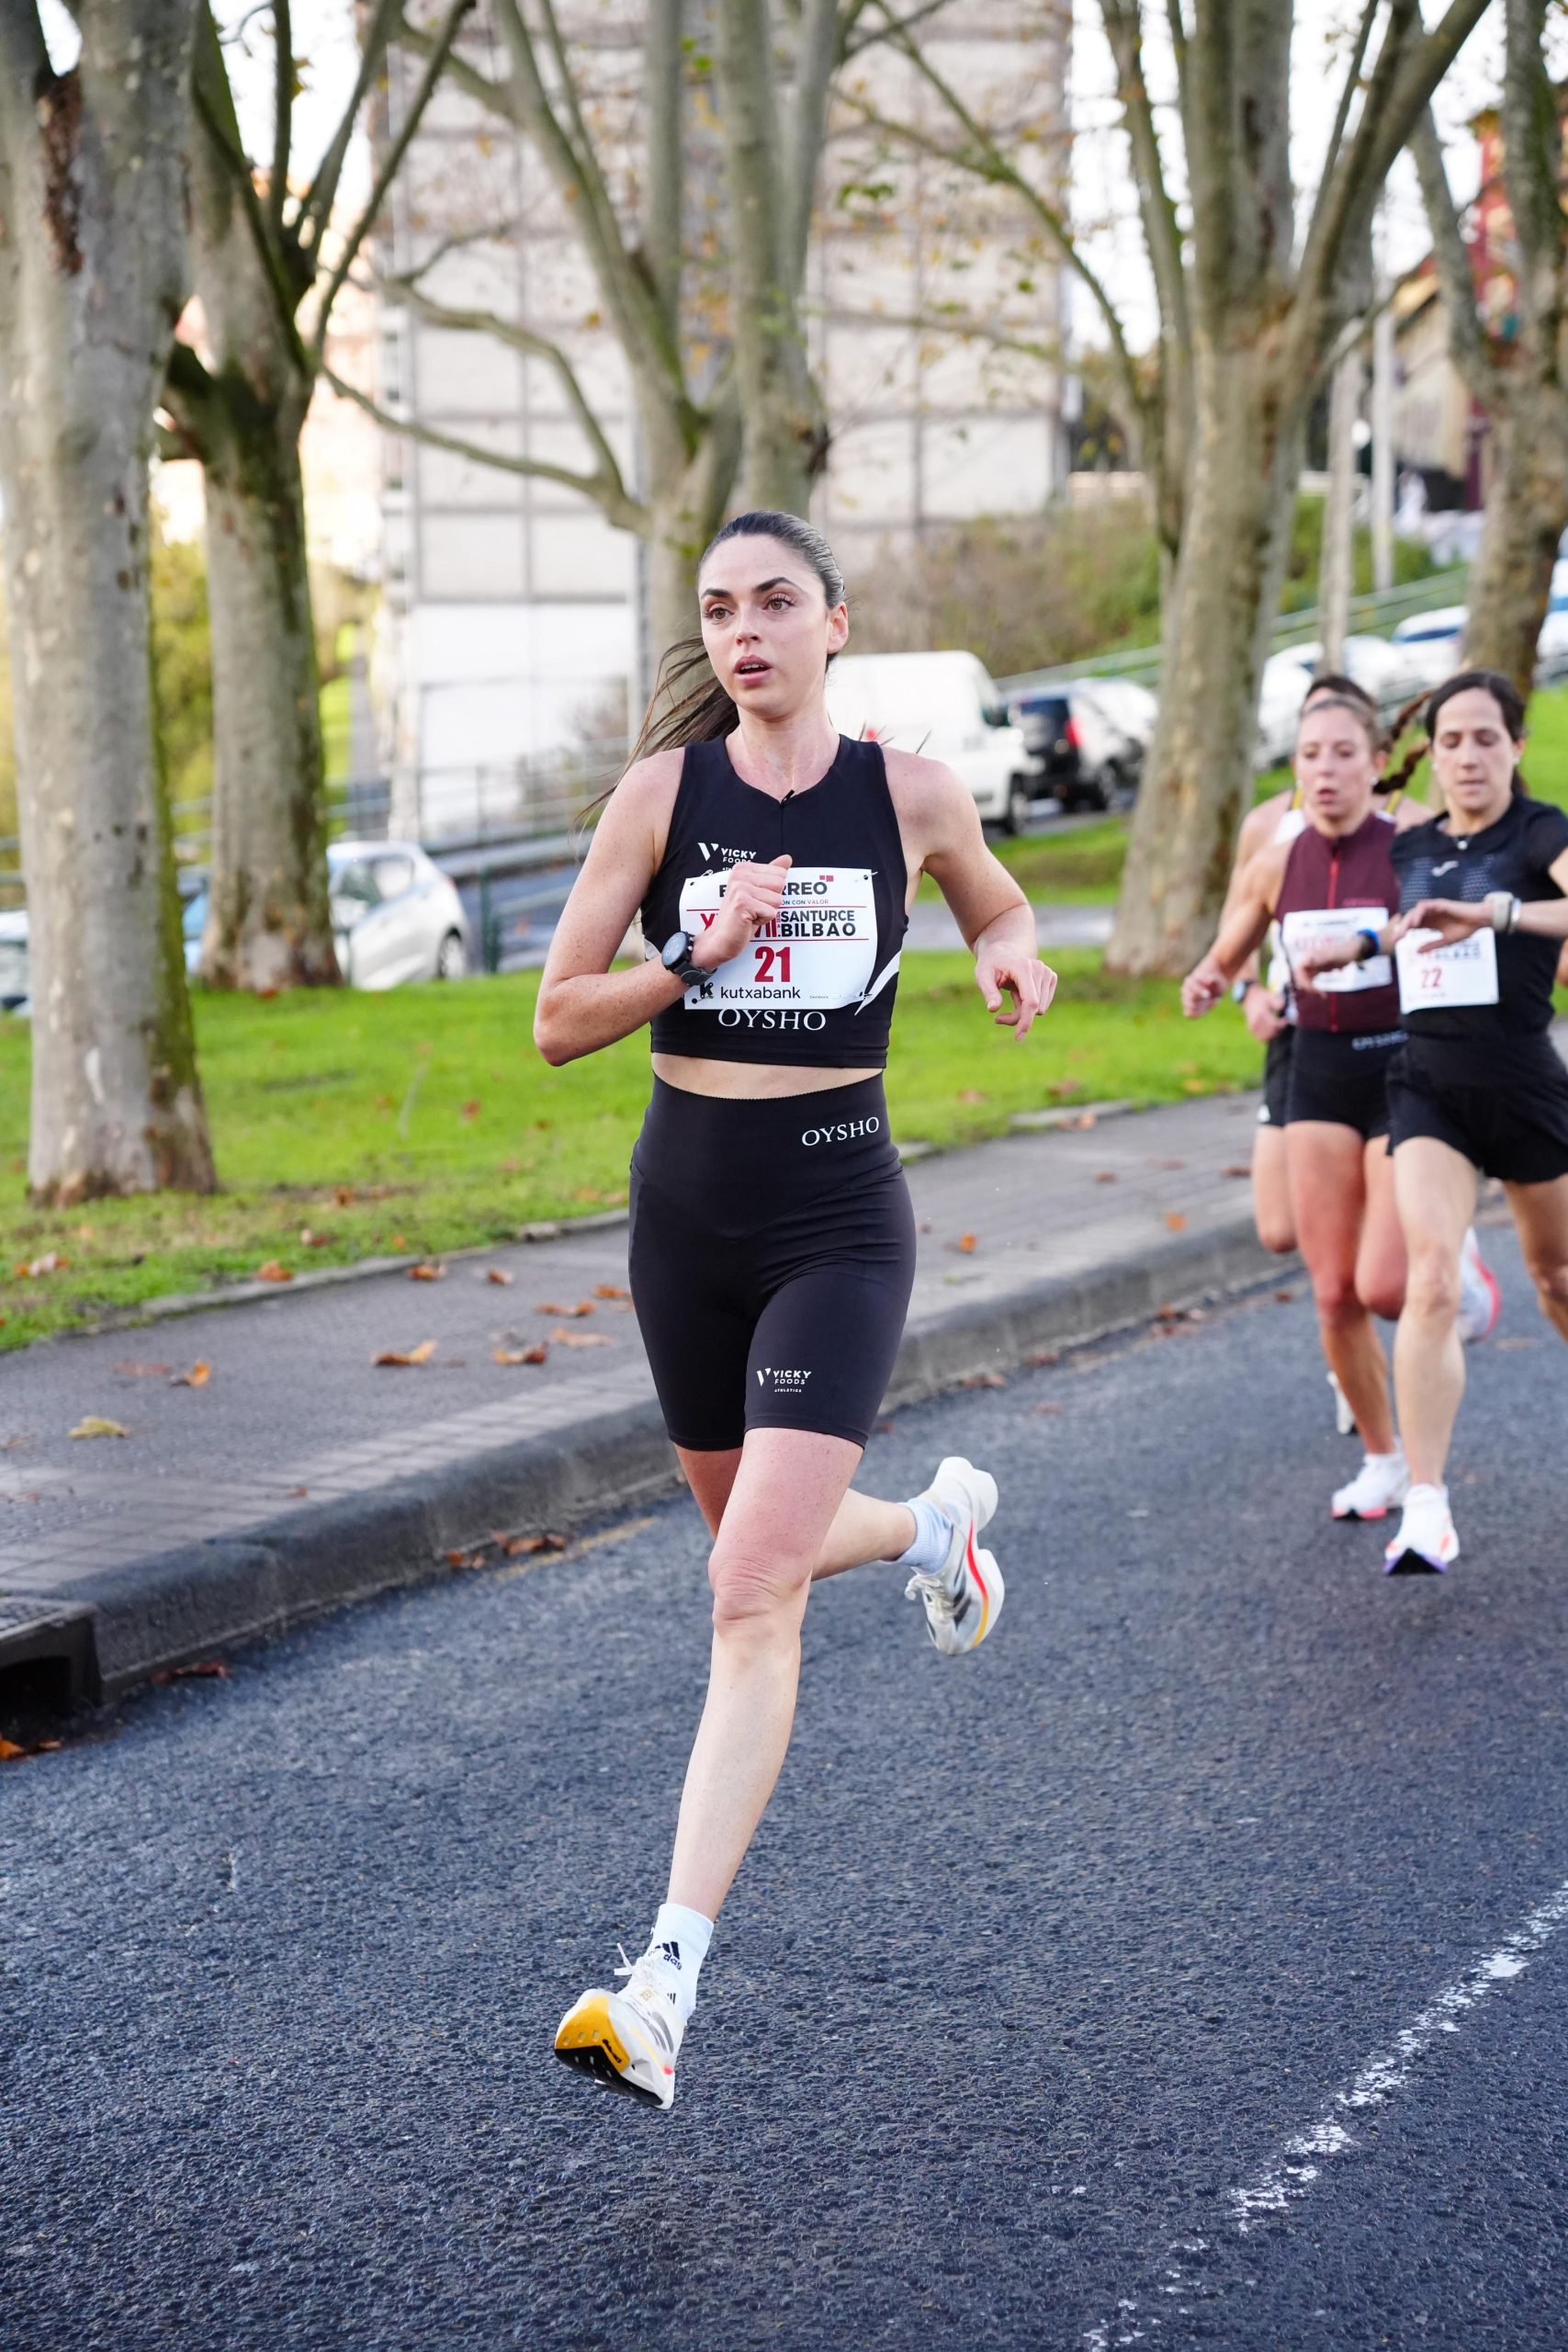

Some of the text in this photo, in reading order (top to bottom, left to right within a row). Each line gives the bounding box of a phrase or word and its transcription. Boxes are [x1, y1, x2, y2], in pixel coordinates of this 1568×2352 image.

[721, 848, 757, 859] VICKY
[782, 881, 828, 895] REO
[781, 910, 855, 922] SANTURCE
[781, 922, 856, 937] BILBAO
[754, 945, 791, 983] 21
[720, 986, 801, 1000] kutxabank
[717, 1009, 827, 1032] OYSHO
[801, 1116, 880, 1147] OYSHO
[773, 1370, 811, 1378] VICKY
